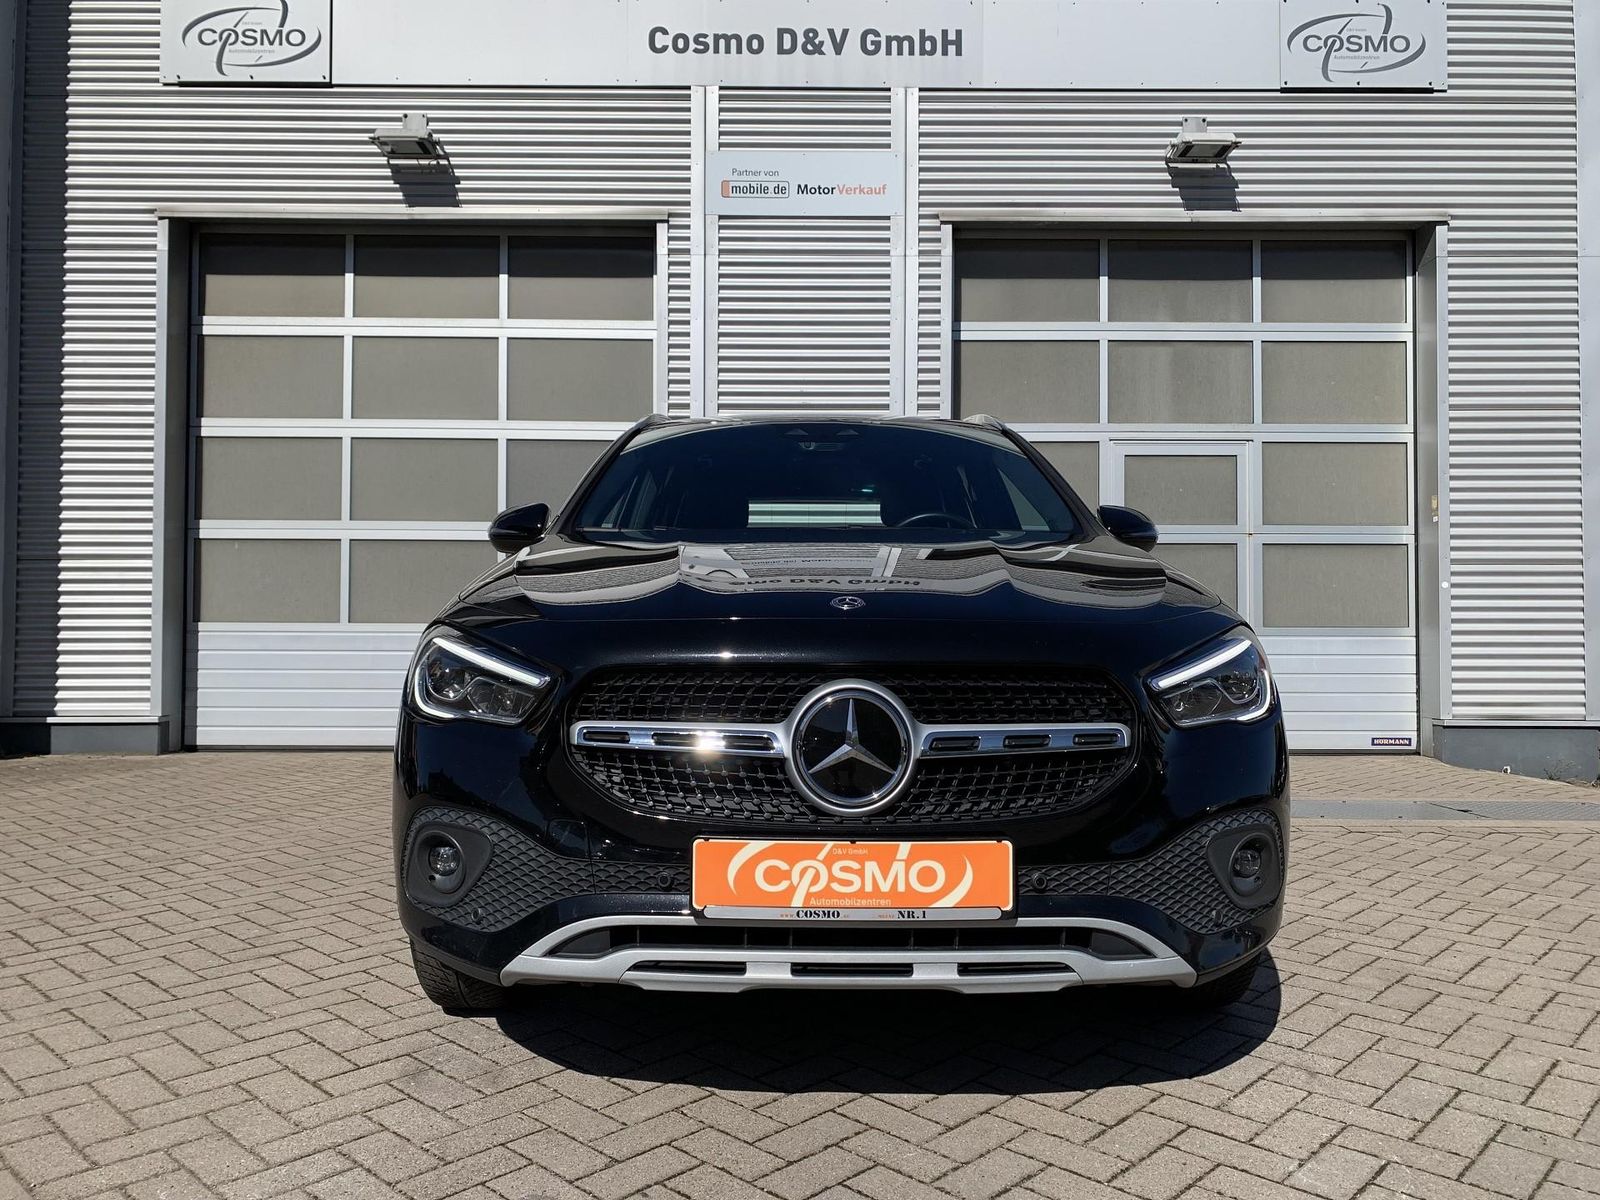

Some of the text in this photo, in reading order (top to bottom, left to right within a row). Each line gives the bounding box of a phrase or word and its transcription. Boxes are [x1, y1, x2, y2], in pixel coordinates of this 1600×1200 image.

[197, 27, 306, 47] COSMO
[648, 26, 963, 56] Cosmo D&V GmbH
[1302, 34, 1411, 53] COSMO
[731, 168, 779, 177] Partner von
[731, 183, 787, 195] mobile.de
[754, 859, 946, 893] COSMO
[810, 897, 892, 906] Automobilzentren
